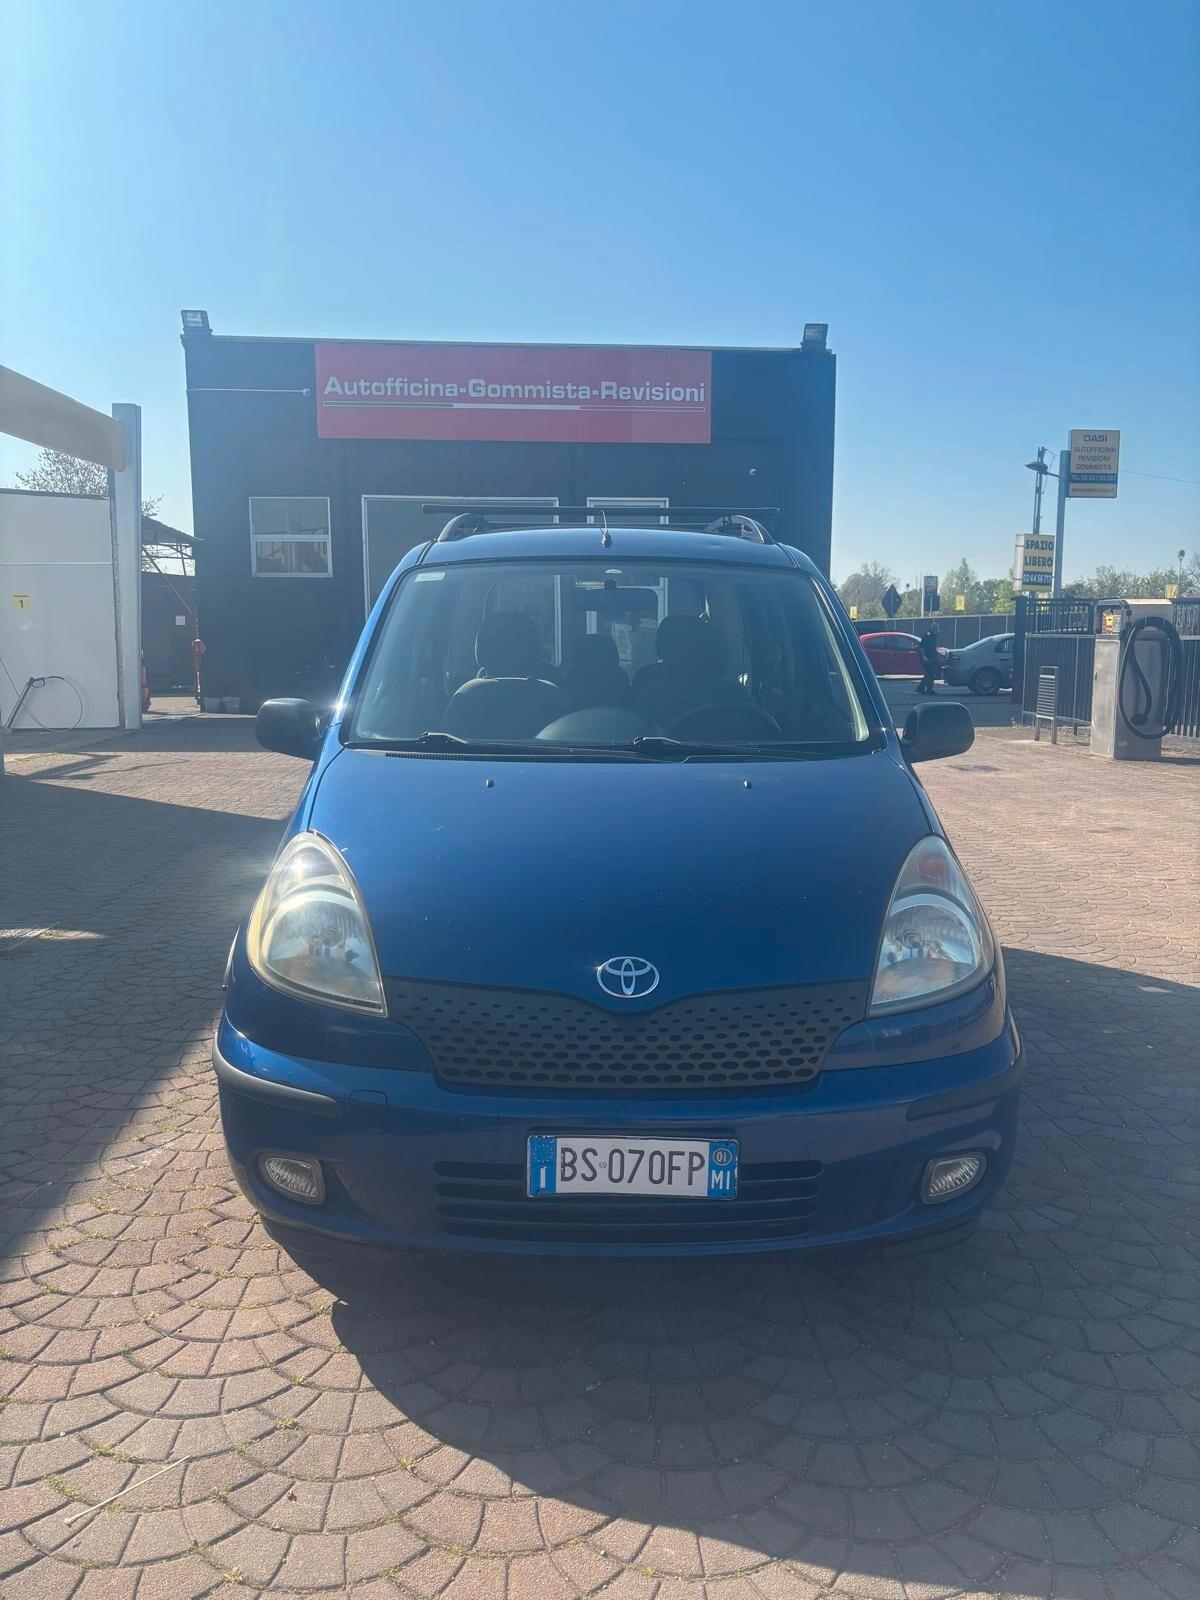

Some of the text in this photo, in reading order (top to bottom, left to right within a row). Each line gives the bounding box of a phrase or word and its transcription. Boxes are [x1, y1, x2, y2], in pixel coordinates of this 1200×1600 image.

[323, 376, 706, 402] Autofficina-Gommista-Revisioni
[1024, 539, 1054, 551] SPAZIO
[1024, 555, 1053, 567] LIBERO
[18, 599, 24, 608] 1
[711, 1169, 731, 1190] MI
